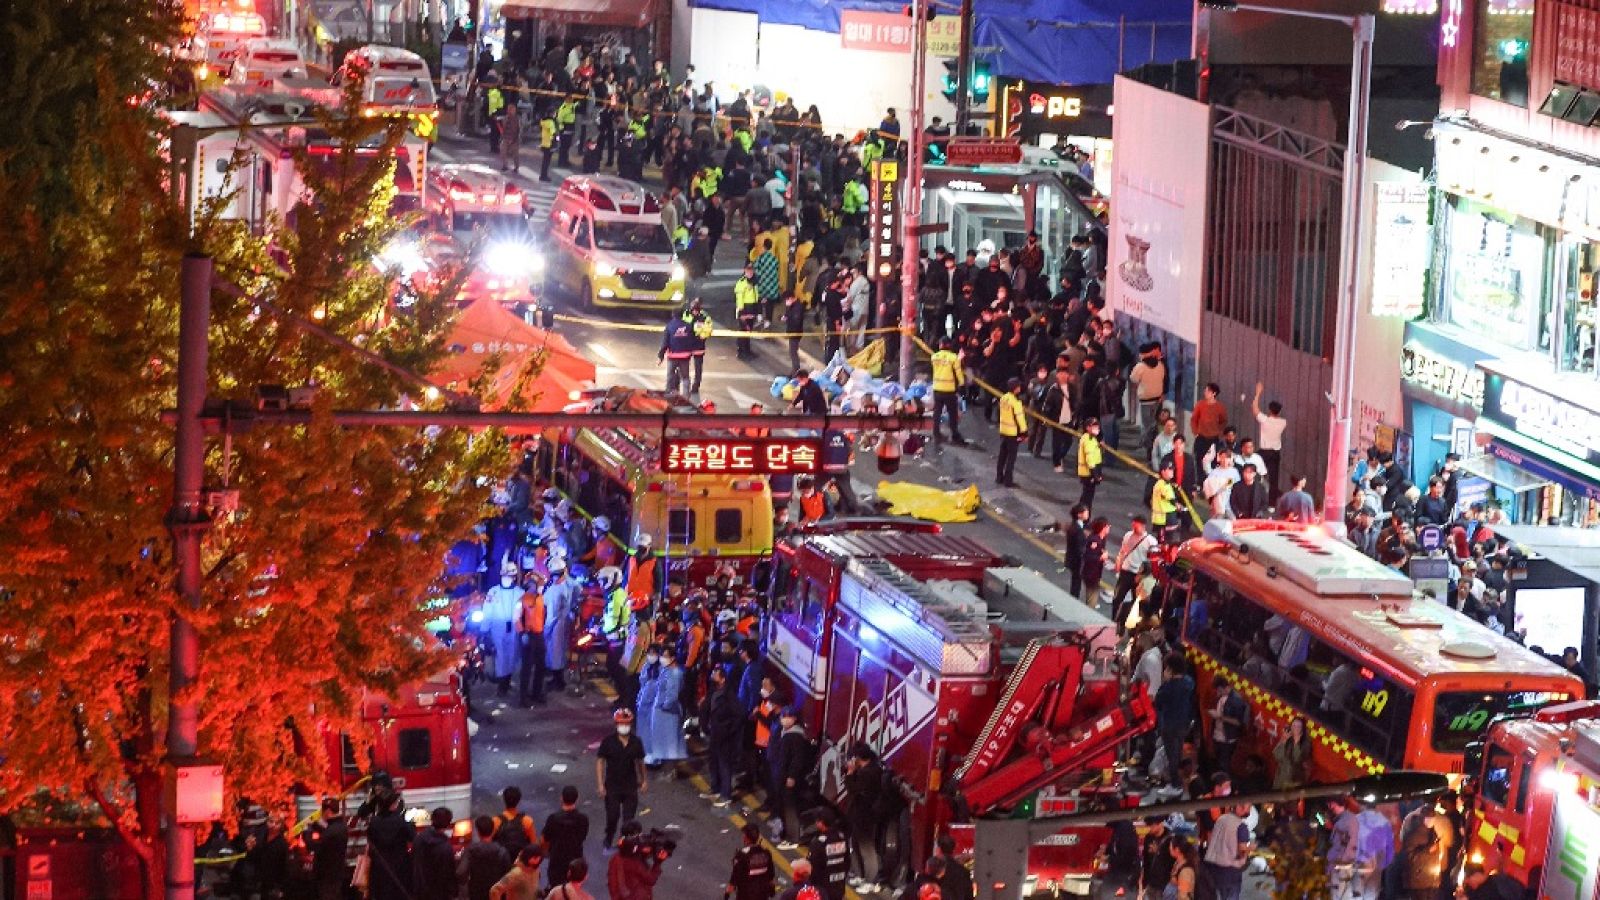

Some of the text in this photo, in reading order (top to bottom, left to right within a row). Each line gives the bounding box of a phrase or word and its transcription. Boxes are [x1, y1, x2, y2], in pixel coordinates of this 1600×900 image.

[766, 444, 816, 470] 단속
[1361, 688, 1389, 718] 119
[1448, 709, 1489, 732] 119
[978, 740, 998, 768] 119
